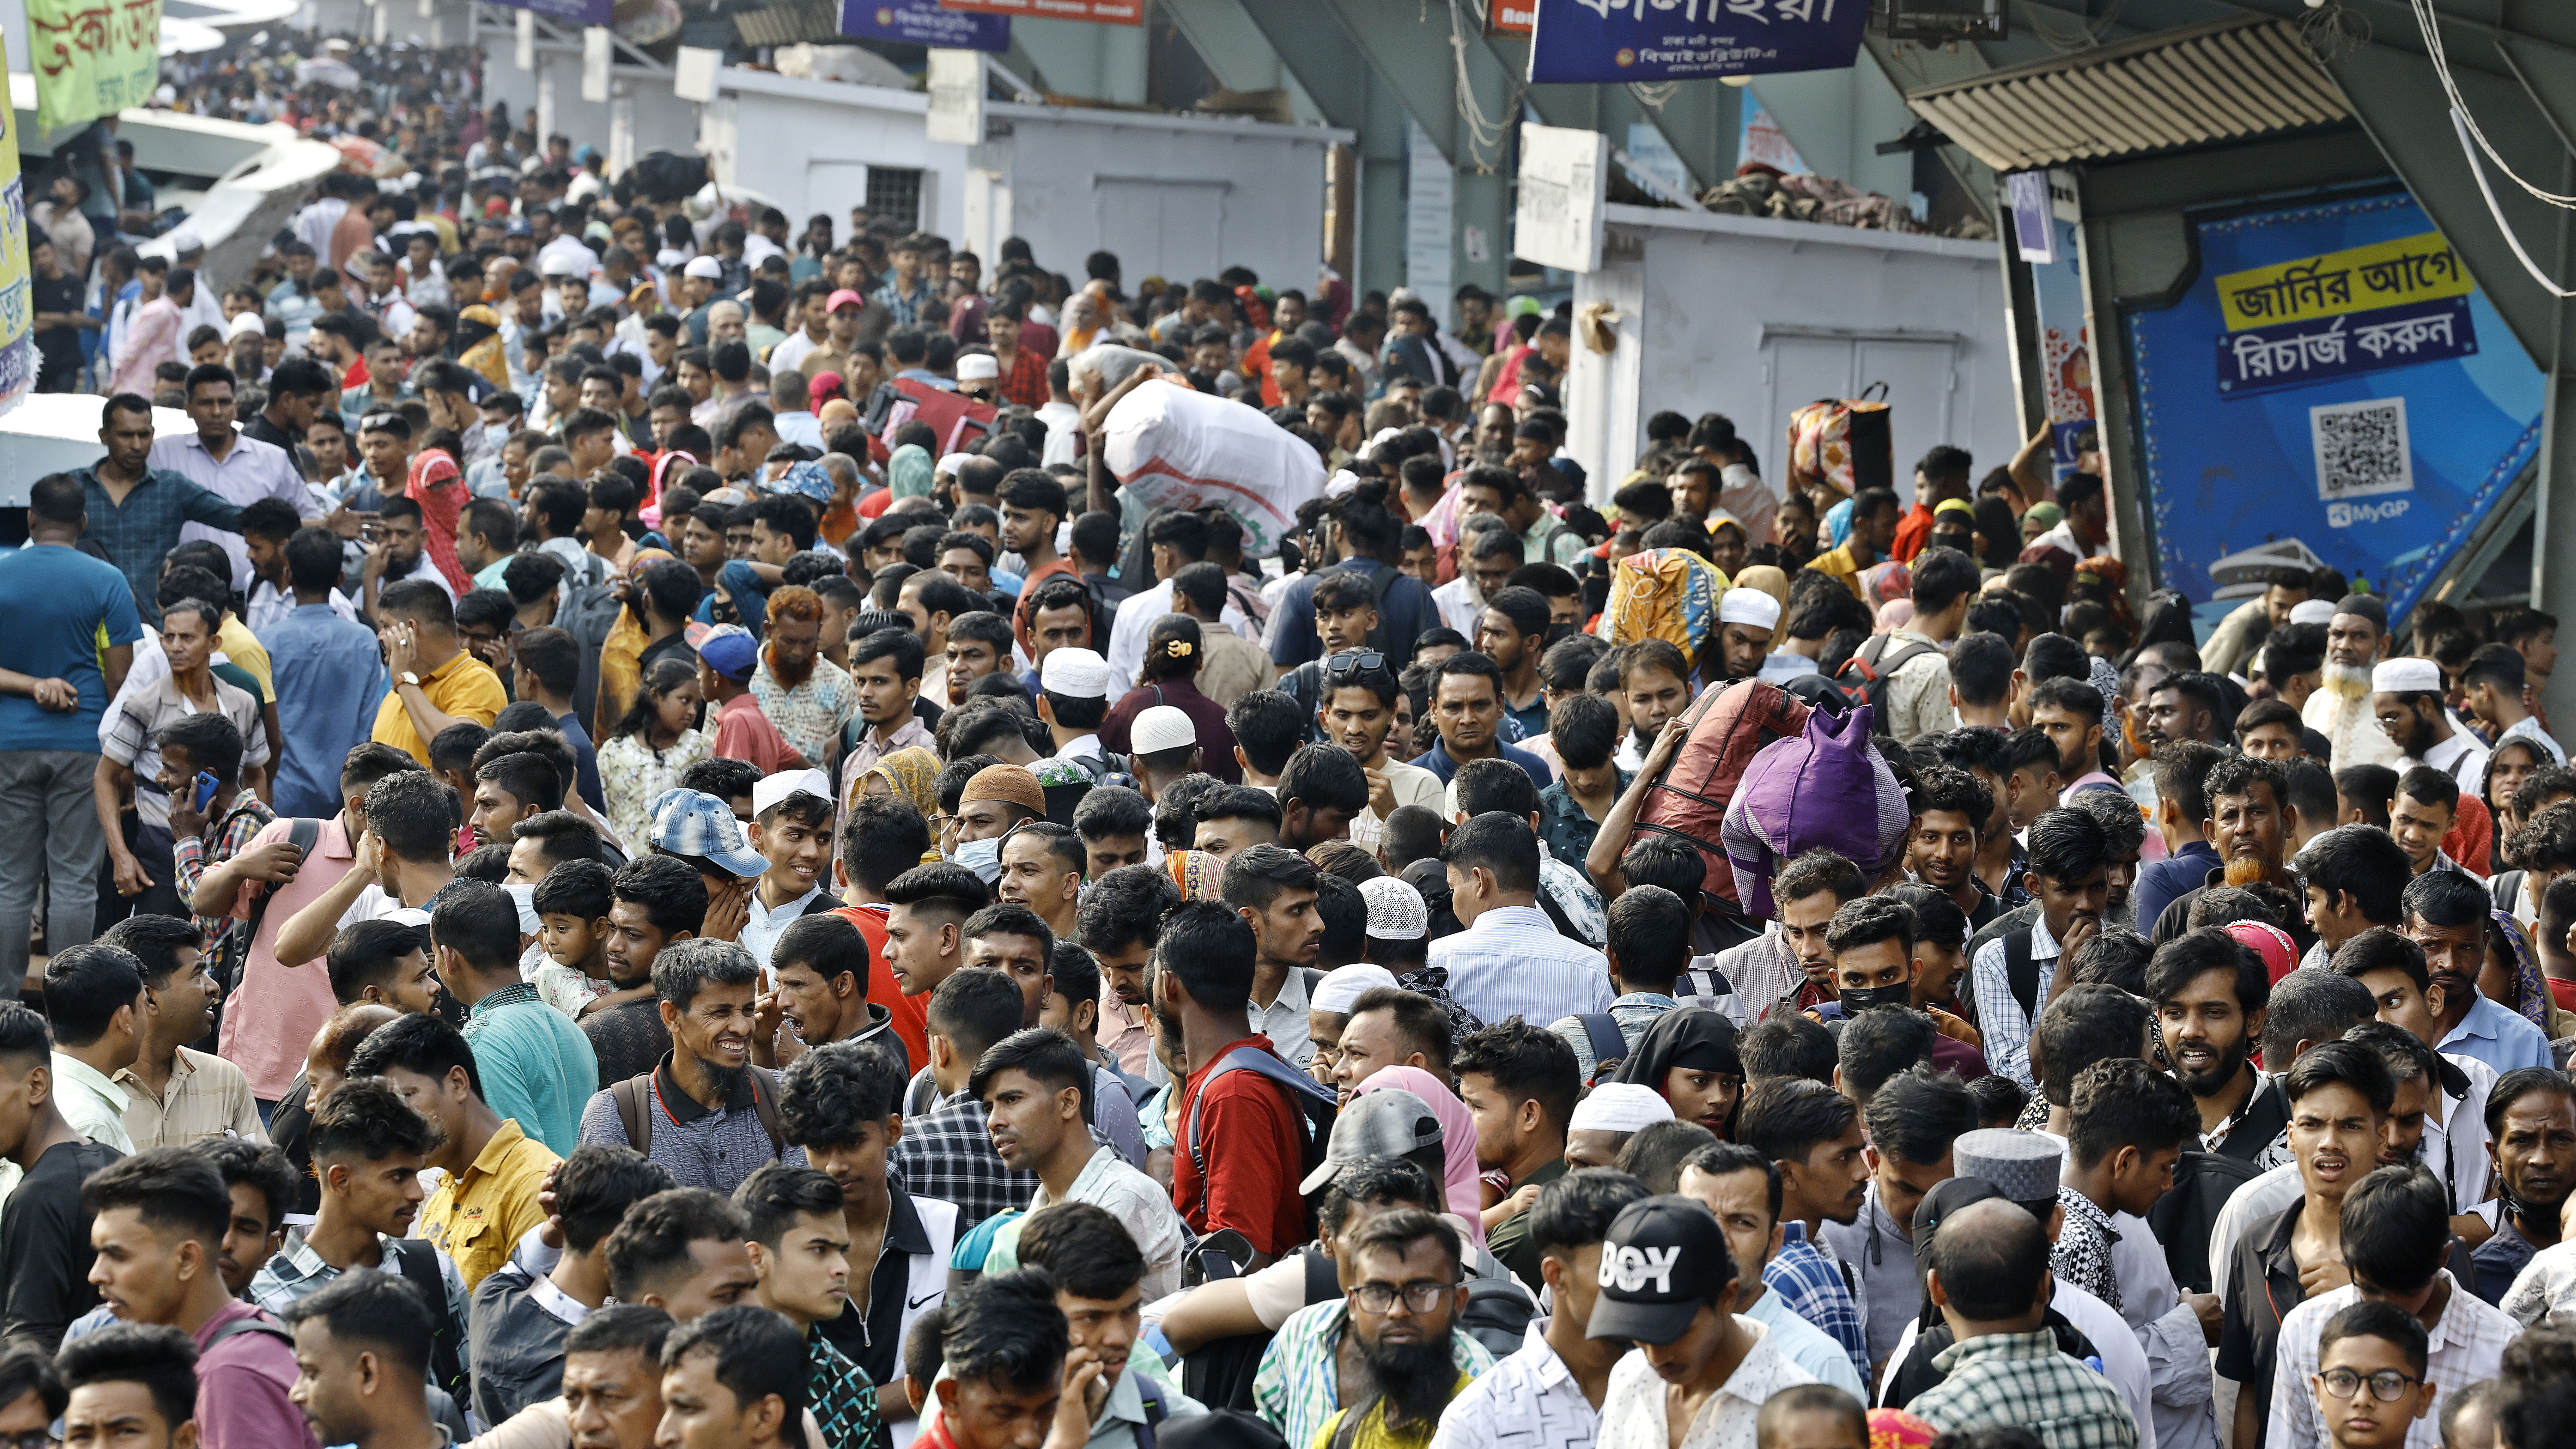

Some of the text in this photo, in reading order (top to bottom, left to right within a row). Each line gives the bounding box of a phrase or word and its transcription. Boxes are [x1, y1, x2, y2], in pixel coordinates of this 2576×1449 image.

[2232, 246, 2459, 318] জার্নির আগে
[2232, 312, 2455, 381] রিচার্জ করুন
[2352, 499, 2410, 523] MyGP
[1598, 1239, 1682, 1294] BOY
